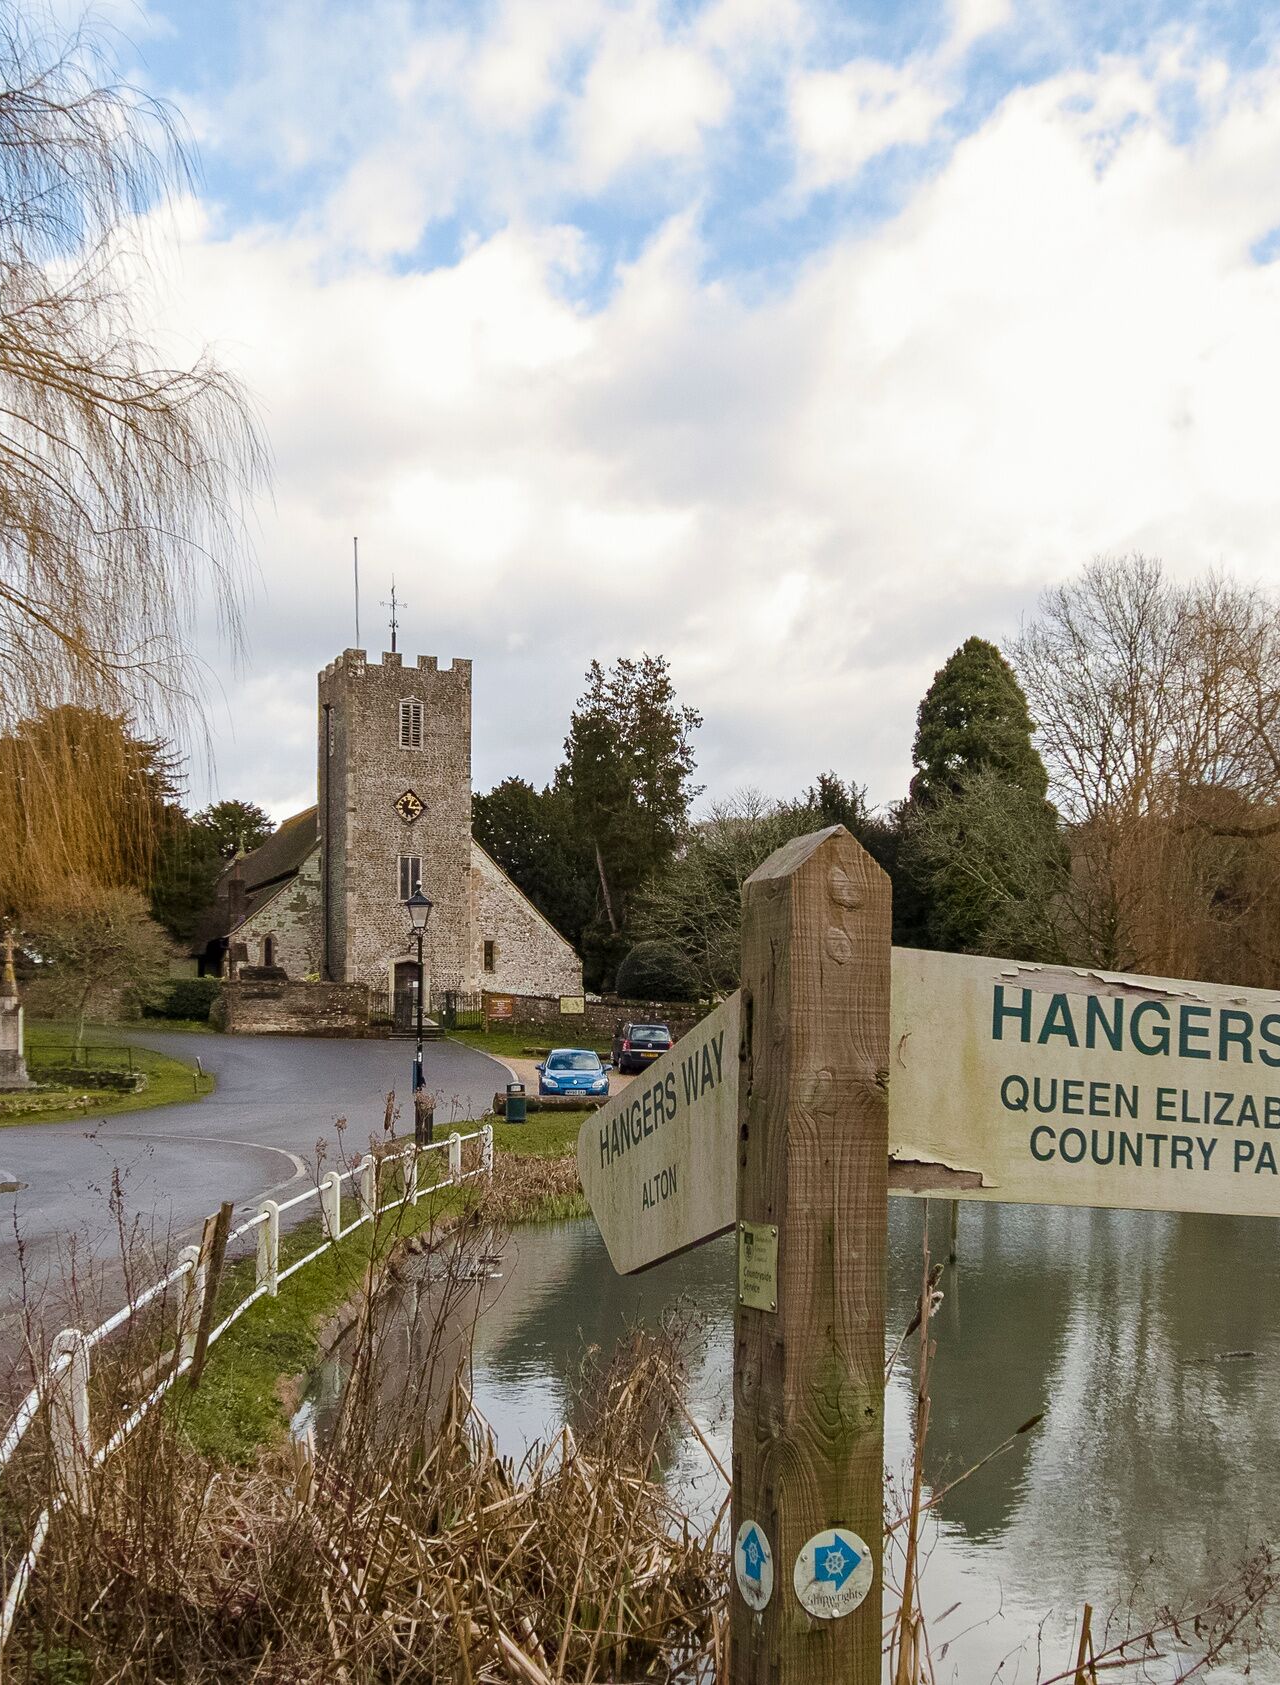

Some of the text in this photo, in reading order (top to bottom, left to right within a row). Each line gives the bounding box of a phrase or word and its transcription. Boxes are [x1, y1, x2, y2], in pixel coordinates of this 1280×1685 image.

[599, 1030, 724, 1169] HANGERS WAY
[1000, 1074, 1139, 1119] QUEEN
[1029, 1125, 1218, 1171] COUNTRY
[642, 1163, 678, 1212] ALTON
